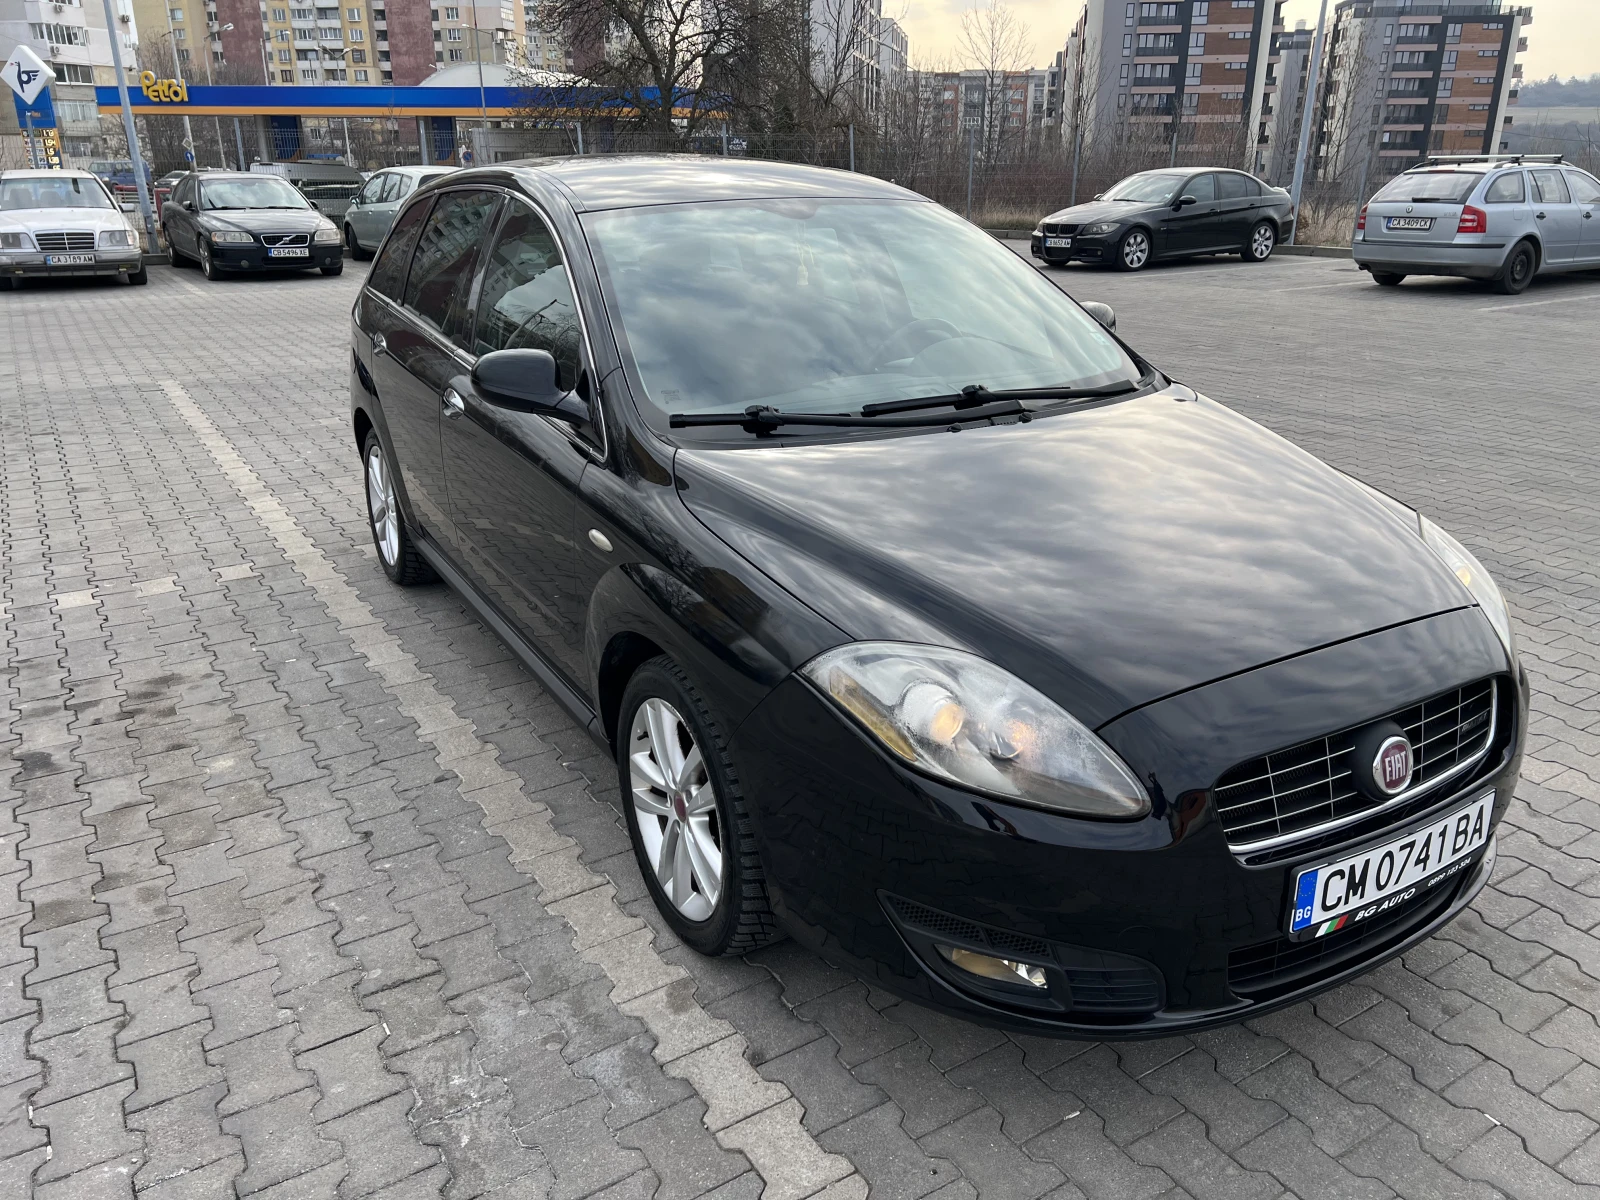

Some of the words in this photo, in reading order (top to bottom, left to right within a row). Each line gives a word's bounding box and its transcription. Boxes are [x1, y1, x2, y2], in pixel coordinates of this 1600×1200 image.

[141, 70, 188, 102] Petrol
[1392, 218, 1401, 226] CA
[1402, 218, 1419, 227] 3409
[1419, 219, 1430, 227] CK
[51, 256, 62, 264] CA
[63, 255, 82, 263] 3189
[83, 255, 94, 263] AM
[1385, 751, 1407, 782] FIAT
[1295, 905, 1312, 922] BG
[1354, 905, 1378, 922] BG
[1378, 888, 1416, 912] AUTO
